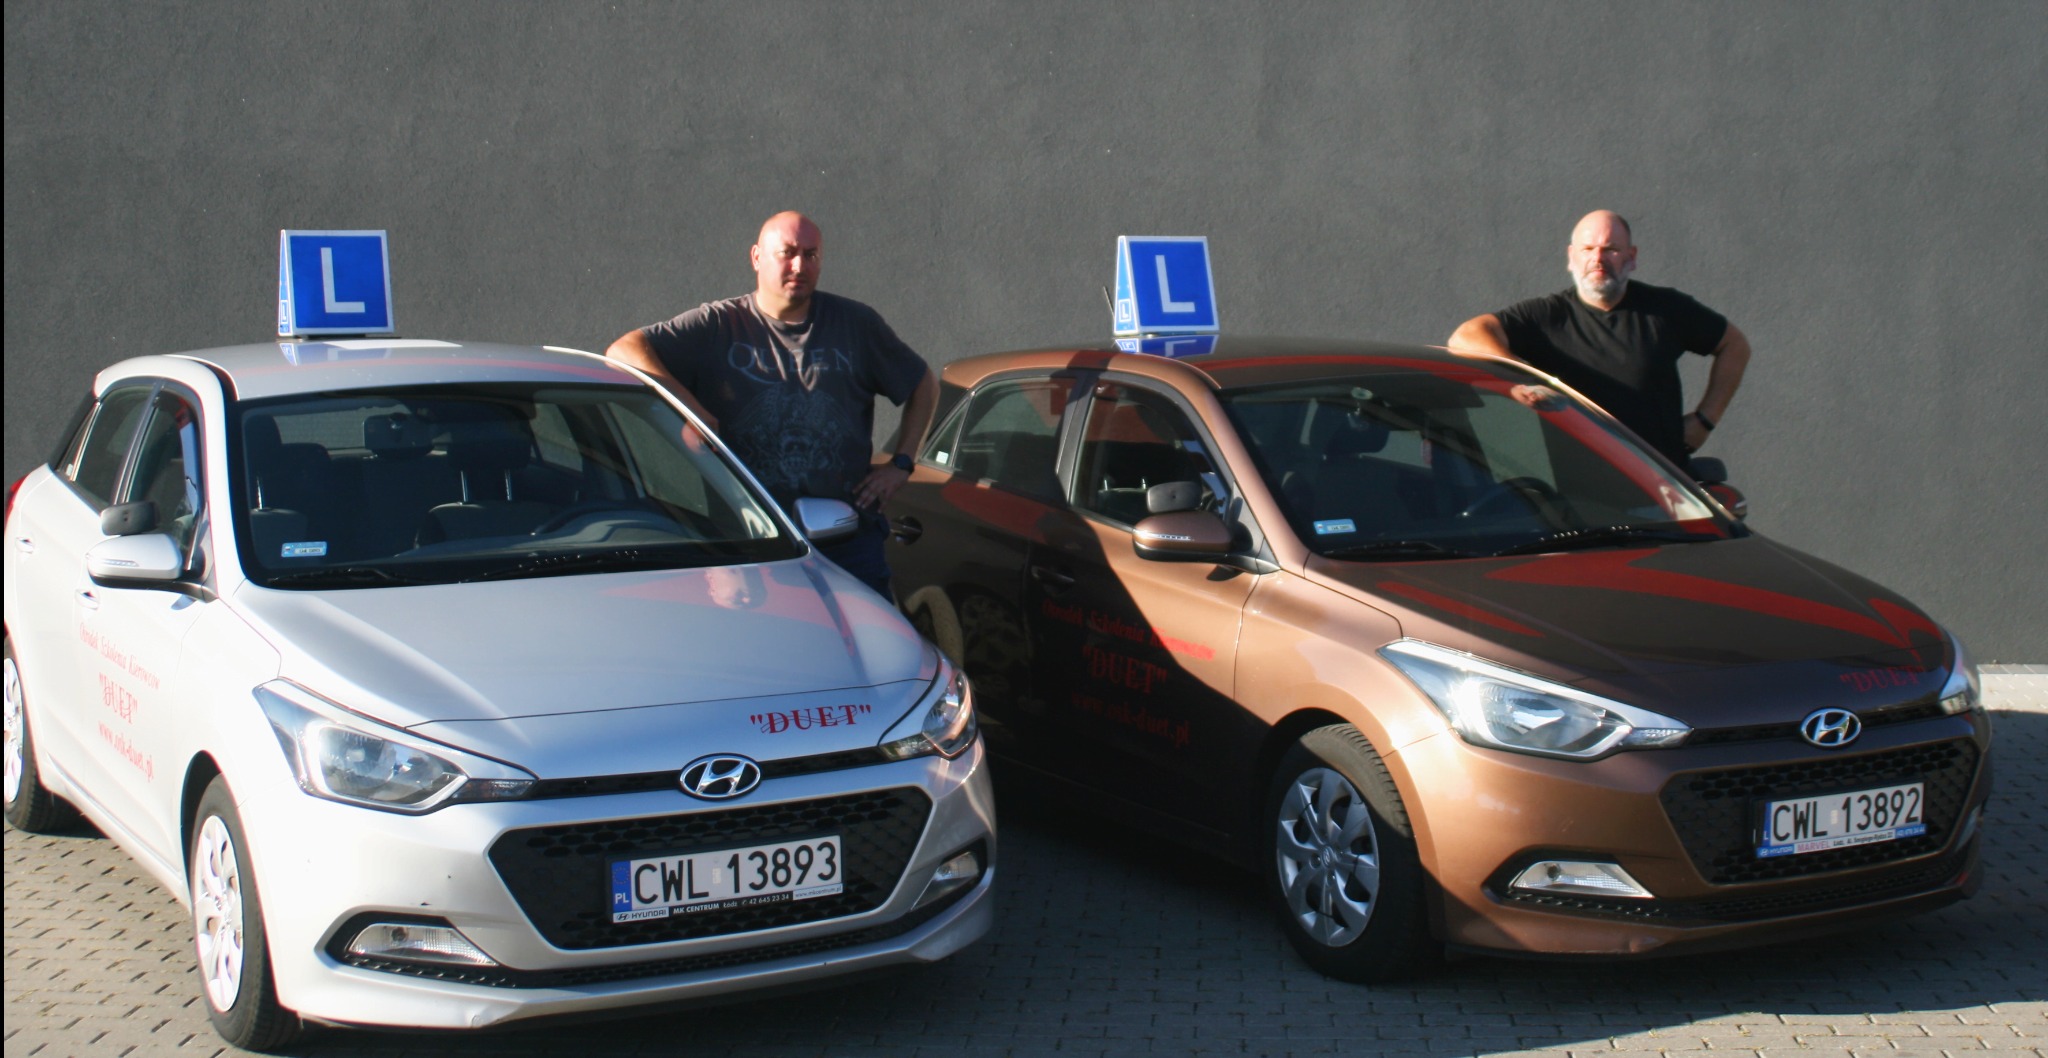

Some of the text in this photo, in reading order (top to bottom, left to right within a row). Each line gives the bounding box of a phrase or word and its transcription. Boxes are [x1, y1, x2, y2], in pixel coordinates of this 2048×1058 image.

[320, 247, 366, 313] L
[1155, 254, 1196, 313] L
[1121, 303, 1129, 319] L
[728, 342, 853, 384] QUEEN
[750, 704, 871, 734] "DUET"
[1773, 787, 1920, 842] CWL 13892
[634, 841, 837, 905] CWL 13893
[615, 892, 630, 904] PL
[631, 910, 667, 919] HYUNDAI
[686, 903, 719, 913] CENTRUM
[758, 896, 771, 904] 645
